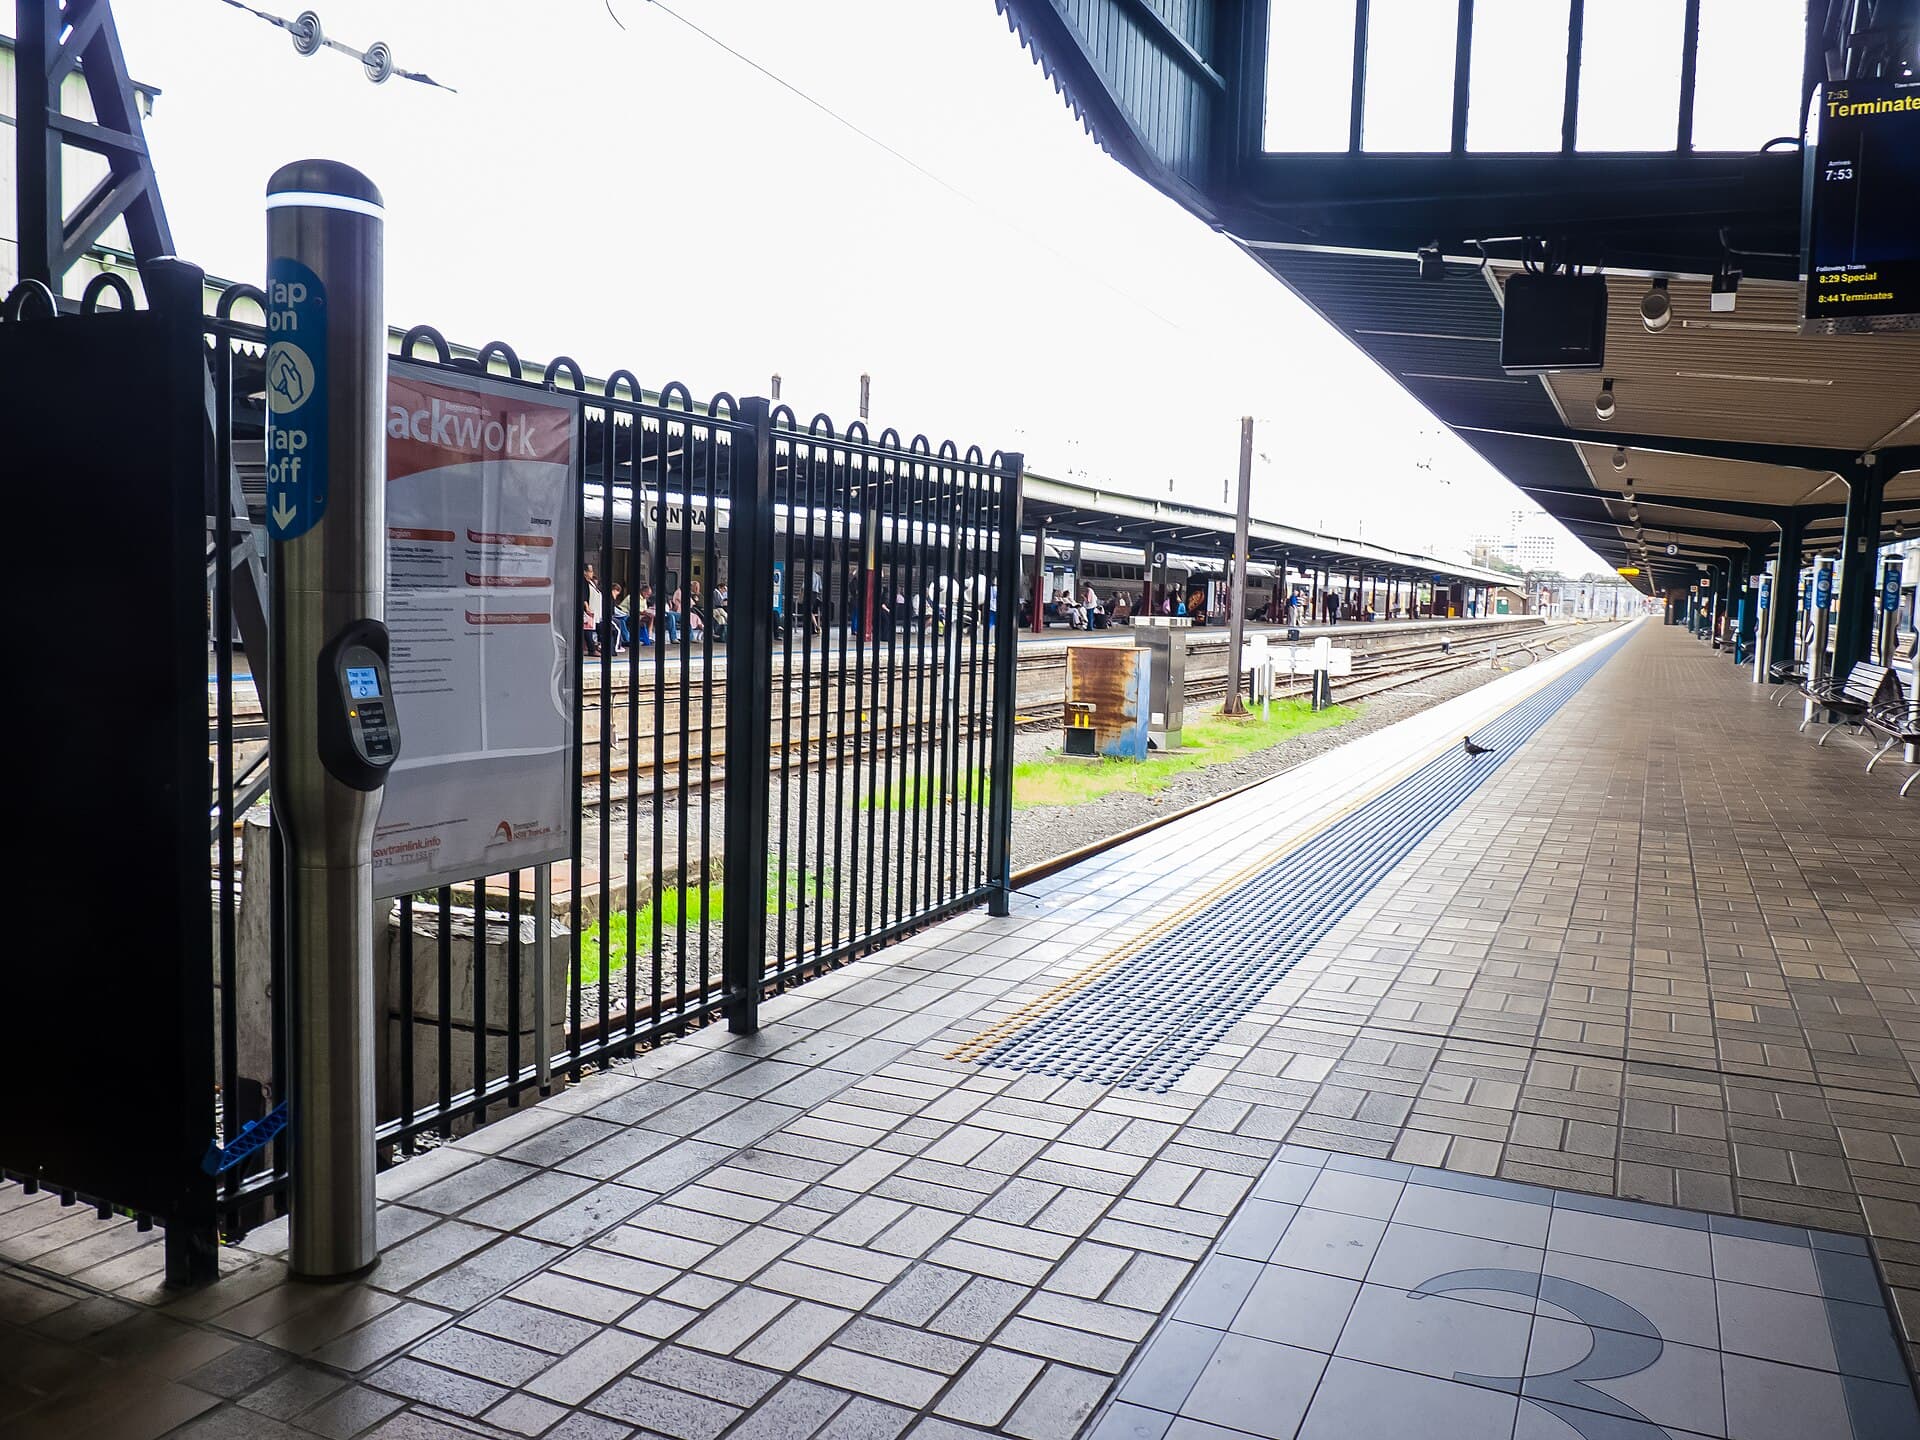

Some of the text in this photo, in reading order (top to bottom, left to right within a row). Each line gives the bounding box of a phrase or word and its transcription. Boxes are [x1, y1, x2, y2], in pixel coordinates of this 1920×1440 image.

[1827, 90, 1848, 99] 7:53
[1825, 168, 1853, 181] 7:53
[1820, 272, 1878, 284] 8:29 Special
[269, 279, 308, 308] Tap
[1818, 292, 1894, 303] 8:44 Terminates
[270, 310, 298, 331] on
[387, 398, 537, 457] ackwork
[269, 425, 308, 454] Tap
[269, 457, 301, 483] off
[650, 506, 708, 525] CNRA
